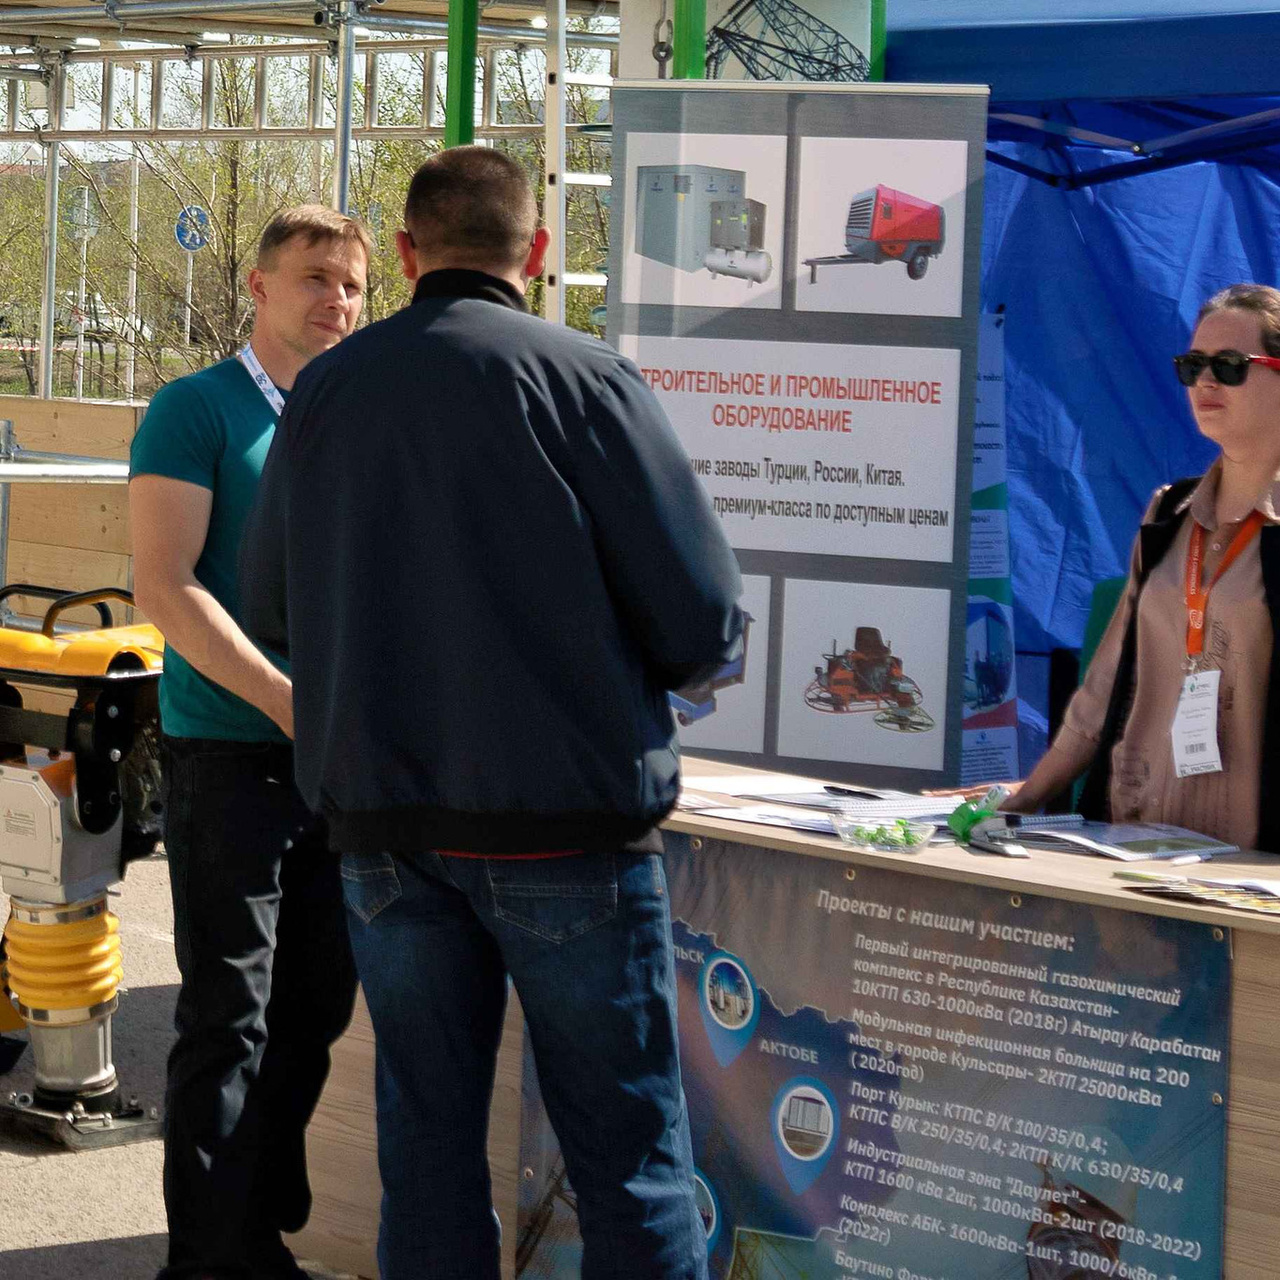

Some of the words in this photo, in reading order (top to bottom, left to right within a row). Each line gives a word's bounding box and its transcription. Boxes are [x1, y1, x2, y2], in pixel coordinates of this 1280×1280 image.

[641, 368, 765, 396] ТРОИТЕЛЬНОЕ
[770, 375, 781, 397] И
[786, 375, 942, 405] ПРОМЫШЛЕННОЕ
[712, 404, 853, 433] ОБОРУДОВАНИЕ
[714, 459, 760, 481] заводы
[764, 457, 810, 485] Турции,
[814, 460, 862, 488] России,
[866, 463, 905, 487] Китая.
[713, 496, 812, 520] премиум-класса
[815, 502, 831, 520] по
[833, 503, 906, 527] доступным
[909, 508, 949, 529] ценам
[817, 889, 892, 920] Проекты
[896, 907, 907, 922] с
[911, 909, 975, 934] нашим
[979, 920, 1075, 952] участием:
[854, 959, 922, 984] комплекс
[926, 974, 934, 986] в
[938, 973, 1026, 1003] Республике
[1030, 988, 1119, 1018] Казахстан-
[855, 933, 910, 958] Первый
[913, 946, 1048, 983] интегрированный
[1052, 972, 1181, 1007] газохимический
[853, 979, 898, 1002] 10КТП
[902, 990, 1004, 1022] 630-1000кВа
[1008, 1010, 1068, 1036] (2018г)
[1071, 1020, 1128, 1049] Атырау
[1131, 1031, 1221, 1062] Карабатан
[853, 1008, 932, 1038] Модульная
[936, 1026, 1051, 1061] инфекционная
[1055, 1048, 1125, 1077] больница
[1129, 1066, 1151, 1082] на
[1156, 1066, 1190, 1088] 200
[760, 1039, 819, 1065] АКТОБЕ
[849, 1032, 883, 1051] мест
[886, 1040, 894, 1053] в
[897, 1042, 947, 1065] городе
[951, 1051, 1034, 1081] Кульсары-
[1038, 1068, 1076, 1089] 2КТП
[1078, 1077, 1162, 1107] 25000кВа
[851, 1081, 886, 1101] Порт
[889, 1090, 940, 1115] Курык:
[944, 1102, 983, 1125] КТПС
[1017, 1119, 1108, 1156] 100/35/0,4;
[847, 1137, 965, 1181] Индустриальная
[967, 1171, 1002, 1190] зона
[849, 1104, 888, 1126] КТПС
[921, 1121, 1007, 1158] 250/35/0,4;
[1009, 1142, 1049, 1165] 2КТП
[1088, 1160, 1185, 1194] 630/35/0,4
[838, 1217, 891, 1247] (2022г)
[841, 1194, 910, 1226] Комплекс
[845, 1161, 874, 1181] КТП
[878, 1169, 915, 1191] 1600
[917, 1179, 943, 1199] кВа
[946, 1186, 978, 1211] 2шт,
[1100, 1220, 1202, 1261] (2018-2022)
[835, 1249, 894, 1280] Баутино
